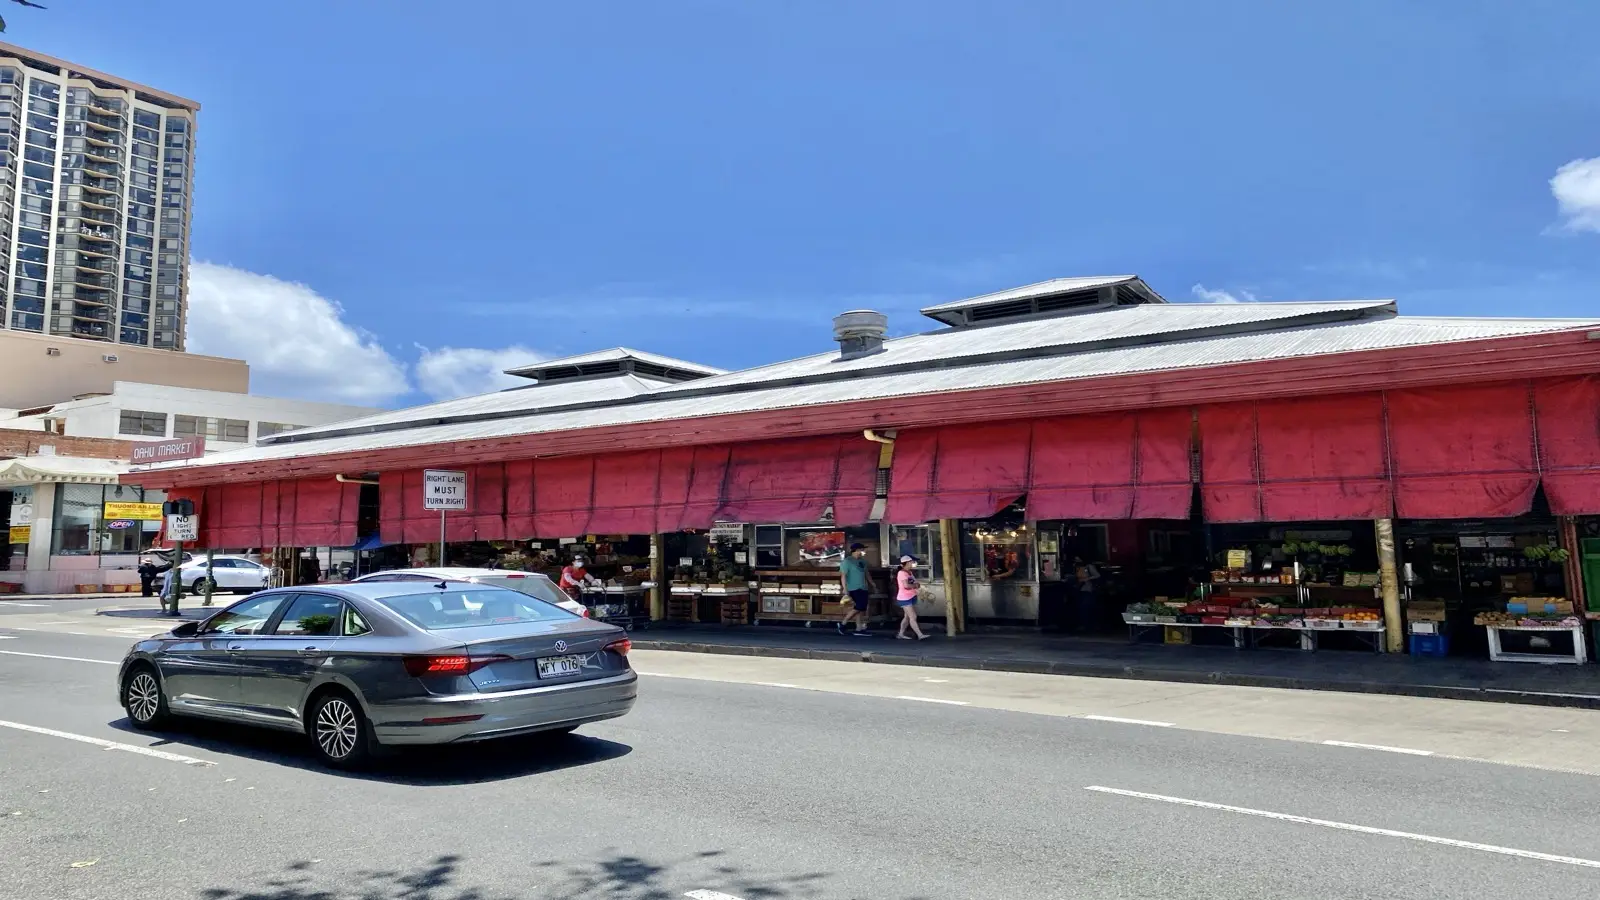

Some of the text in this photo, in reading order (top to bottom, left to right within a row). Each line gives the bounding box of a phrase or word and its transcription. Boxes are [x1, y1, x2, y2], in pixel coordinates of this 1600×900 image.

[133, 442, 192, 460] OAHU MARKET
[434, 486, 457, 494] MUST
[540, 659, 578, 674] WFY 076
